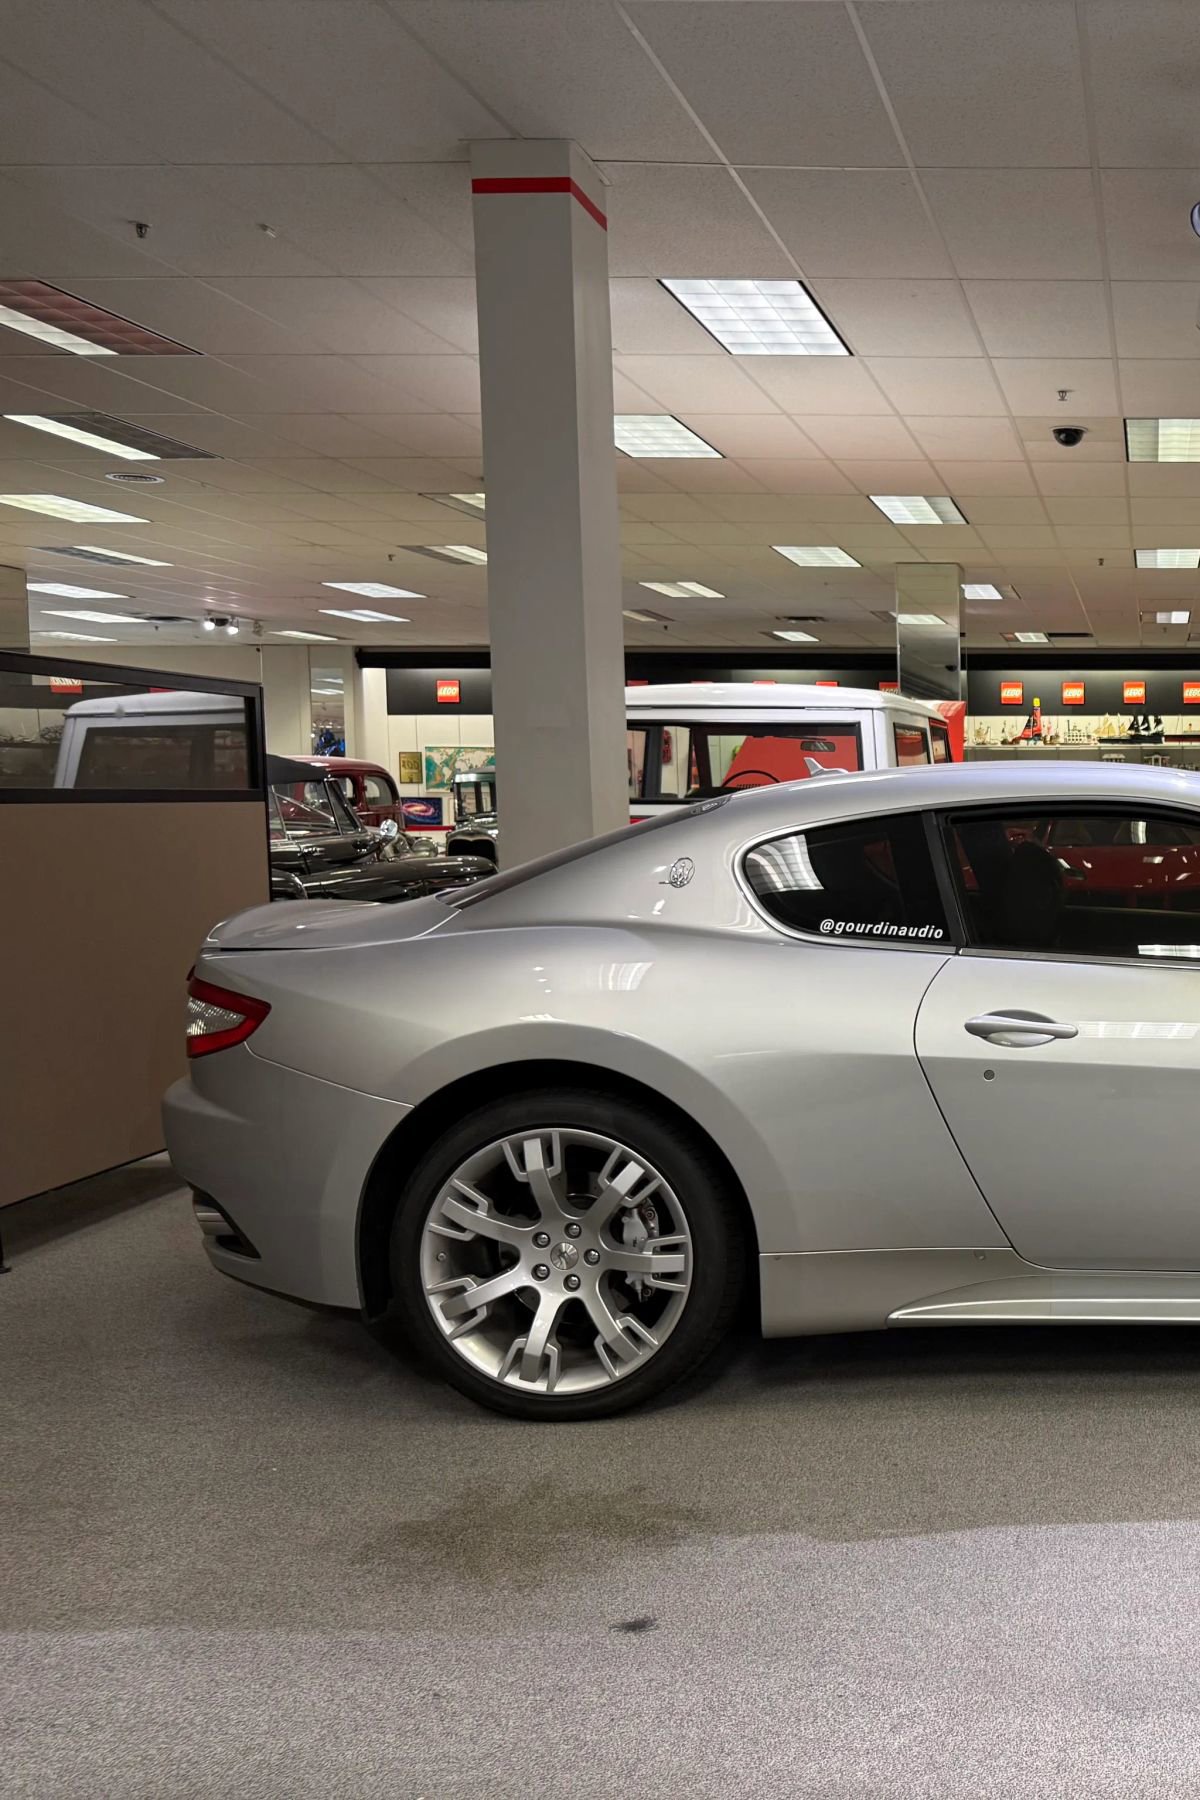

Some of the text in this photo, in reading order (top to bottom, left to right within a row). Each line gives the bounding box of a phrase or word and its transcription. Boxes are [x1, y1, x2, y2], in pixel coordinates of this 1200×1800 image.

[439, 687, 457, 697] LEGO
[1004, 688, 1021, 697] LEGO
[1064, 688, 1082, 697] LEGO
[1125, 687, 1144, 697] LEGO
[820, 918, 944, 939] @gourdinaudio
